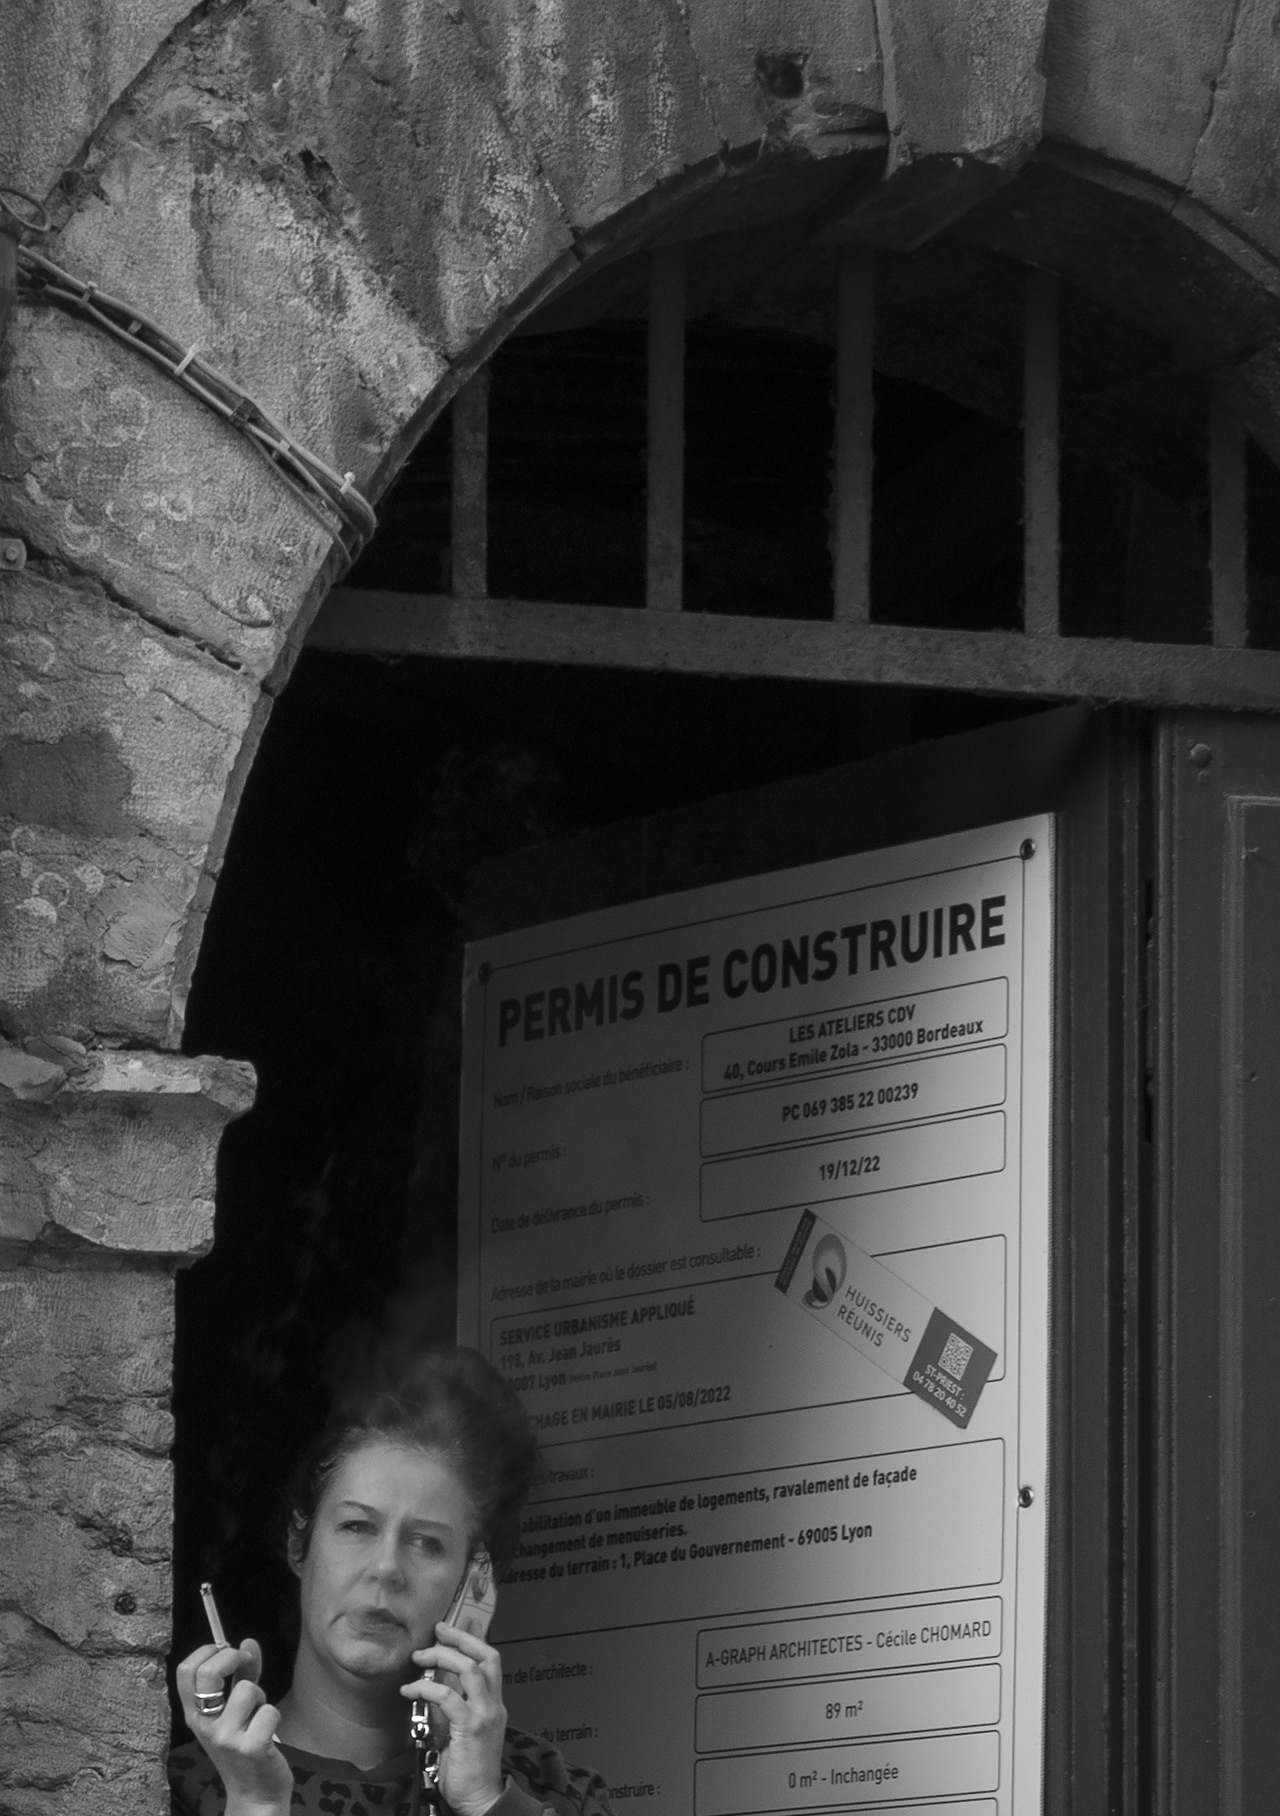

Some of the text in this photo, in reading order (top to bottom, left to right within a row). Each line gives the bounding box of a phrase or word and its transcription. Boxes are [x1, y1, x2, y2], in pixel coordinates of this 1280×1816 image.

[498, 894, 1006, 1048] PERMIS DE CONSTRUIRE
[788, 1003, 916, 1043] LES ATELIERS CDV
[723, 1020, 984, 1080] 40, Cours Emile Zola 33000 Bordeaux
[493, 1057, 683, 1109] Nom Raison sociale du bénéficiaire
[781, 1082, 919, 1122] PC 069 385 22 00239
[508, 1151, 522, 1168] du
[523, 1143, 561, 1169] permis
[818, 1155, 881, 1180] 19/12/22
[491, 1191, 643, 1234] Date de délivrance du permis
[490, 1243, 755, 1302] Adresse de la mairie où le dossier est consultable
[499, 1294, 695, 1346] SERVICE URBANISME APPLIQUÉ
[837, 1304, 885, 1347] RÉUNIS
[846, 1285, 911, 1342] HUISSIERS
[499, 1335, 621, 1369] 198, Av. Jean Jaurès
[510, 1374, 536, 1392] 007
[571, 1406, 587, 1424] EN
[590, 1398, 636, 1421] MAIRIE
[638, 1396, 654, 1414] LE
[656, 1384, 731, 1411] 05/08/2022
[548, 1466, 588, 1483] travaux
[521, 1465, 917, 1533] abilitation d'un immeuble de logements, ravalement de façade
[548, 1562, 564, 1578] du
[566, 1555, 610, 1575] terrain
[620, 1552, 631, 1570] 1,
[633, 1550, 667, 1567] Place
[669, 1546, 686, 1562] du
[688, 1532, 785, 1559] Gouvernement
[797, 1525, 838, 1546] 69005
[840, 1524, 873, 1543] Lyon
[588, 1532, 604, 1548] de
[606, 1522, 688, 1545] menuiseries.
[705, 1620, 991, 1667] A-GRAPH ARCHITECTES Cécile CHOMARD
[513, 1668, 527, 1684] de
[529, 1662, 587, 1682] l'architecte
[825, 1702, 841, 1719] 89
[556, 1723, 592, 1742] terrain
[607, 1781, 654, 1799] nstruire
[787, 1772, 795, 1789] 0
[830, 1762, 899, 1785] Inchangée
